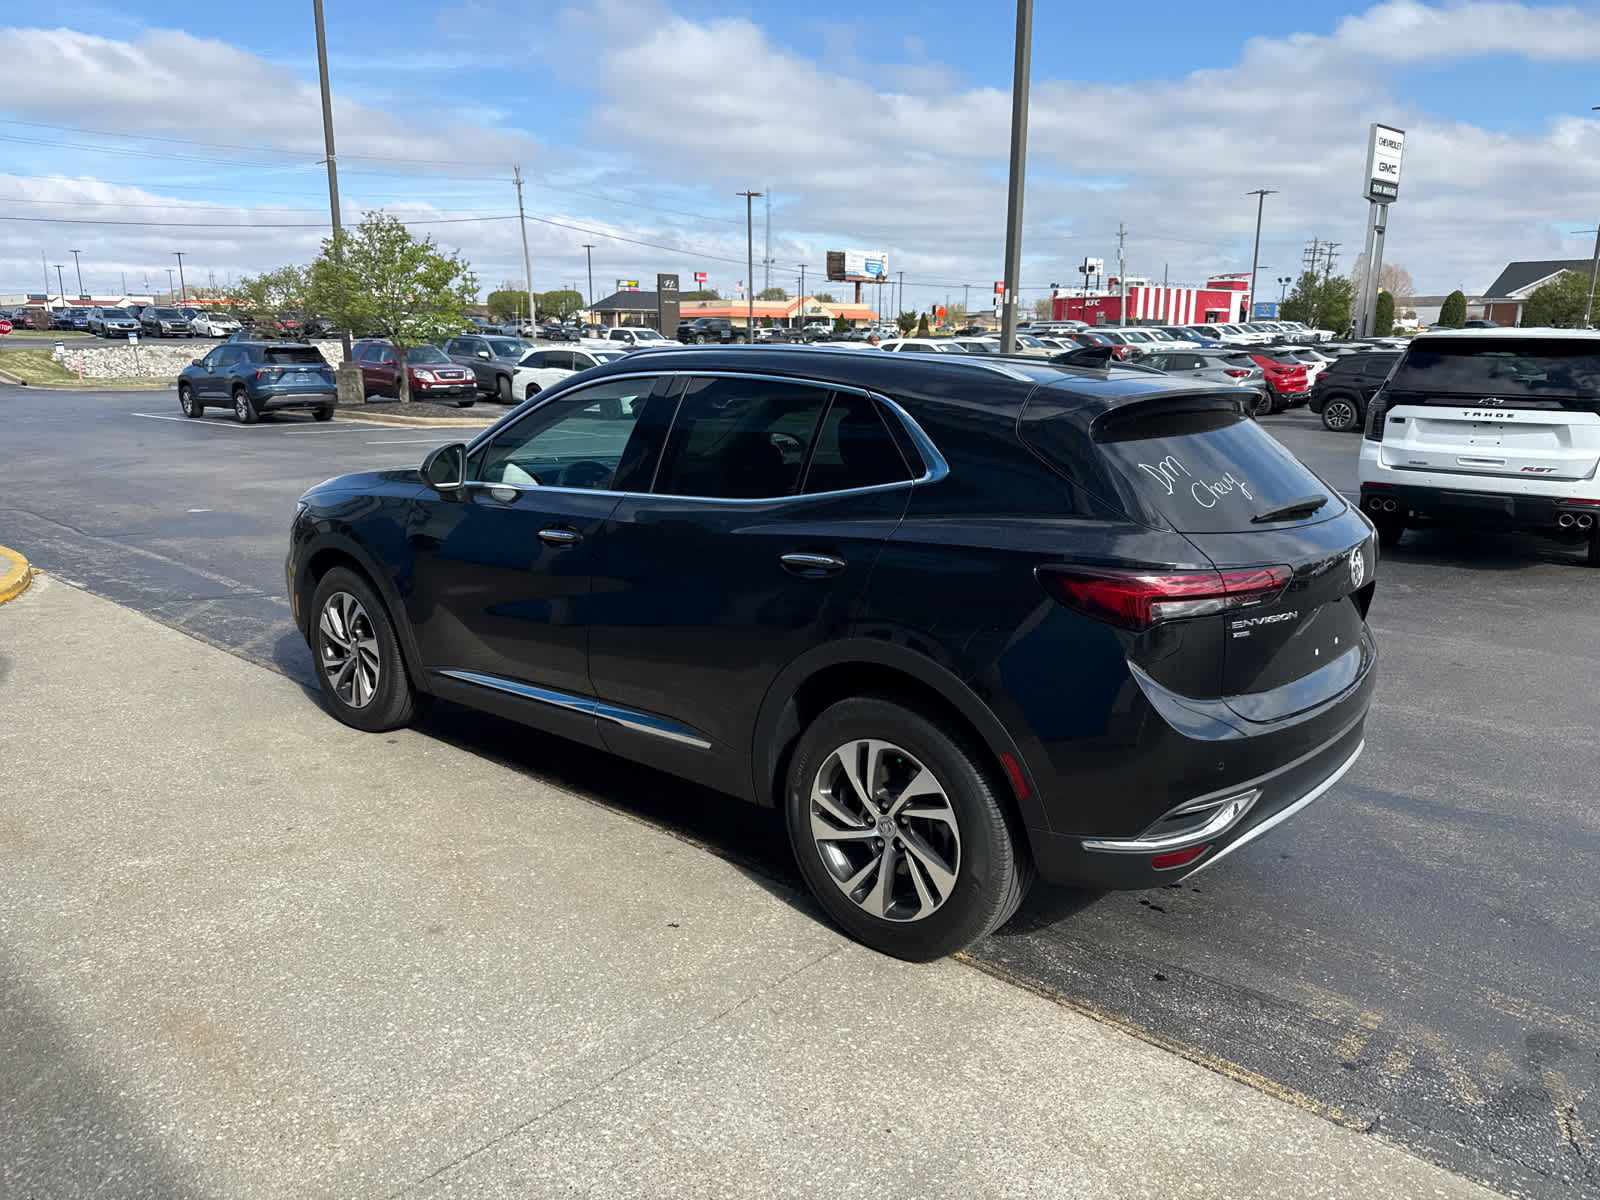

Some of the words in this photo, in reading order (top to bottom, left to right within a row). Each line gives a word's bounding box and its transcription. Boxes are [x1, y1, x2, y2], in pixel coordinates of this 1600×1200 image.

[1379, 137, 1402, 150] CHEVROLET
[1379, 162, 1397, 175] GMC
[1231, 610, 1298, 629] ENVISION
